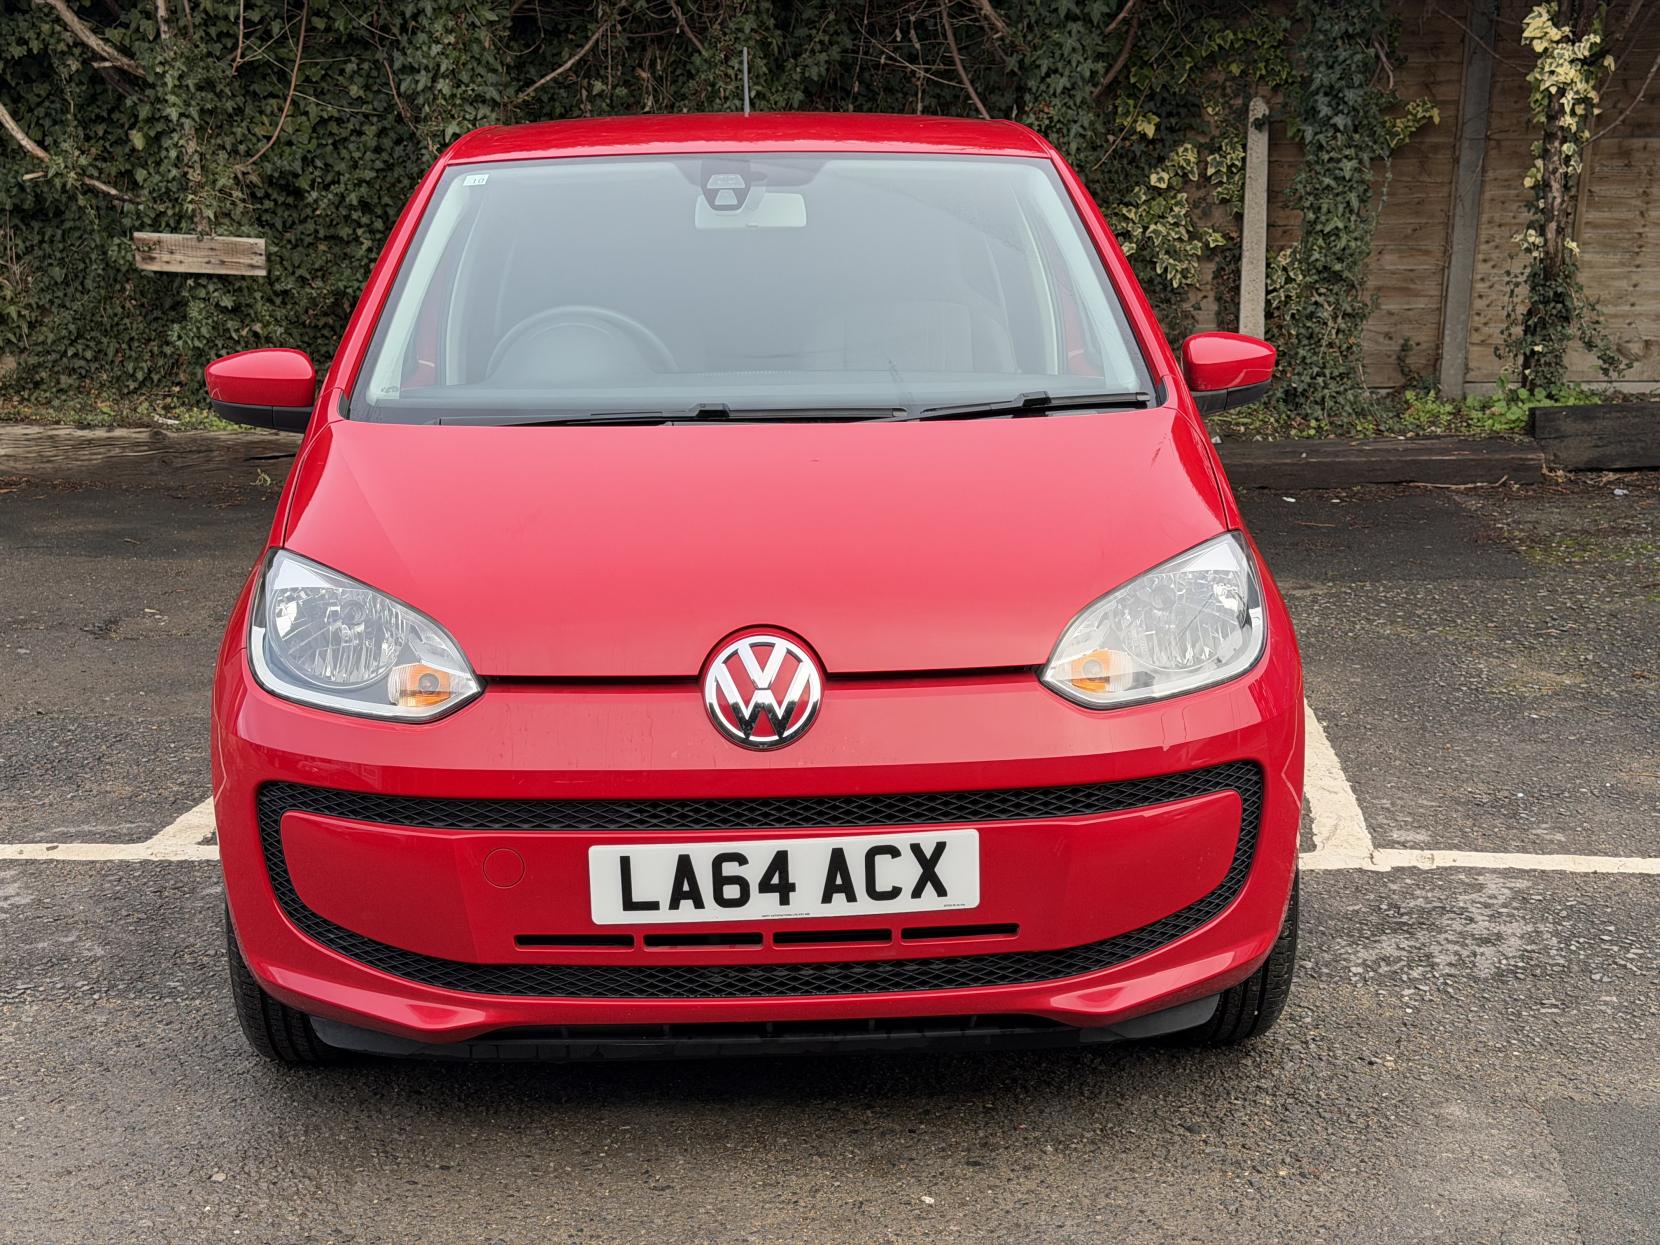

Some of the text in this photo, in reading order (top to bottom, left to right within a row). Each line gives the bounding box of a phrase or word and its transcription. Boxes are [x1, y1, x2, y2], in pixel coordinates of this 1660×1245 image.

[709, 638, 816, 744] VW
[620, 842, 947, 911] LA64 ACX
